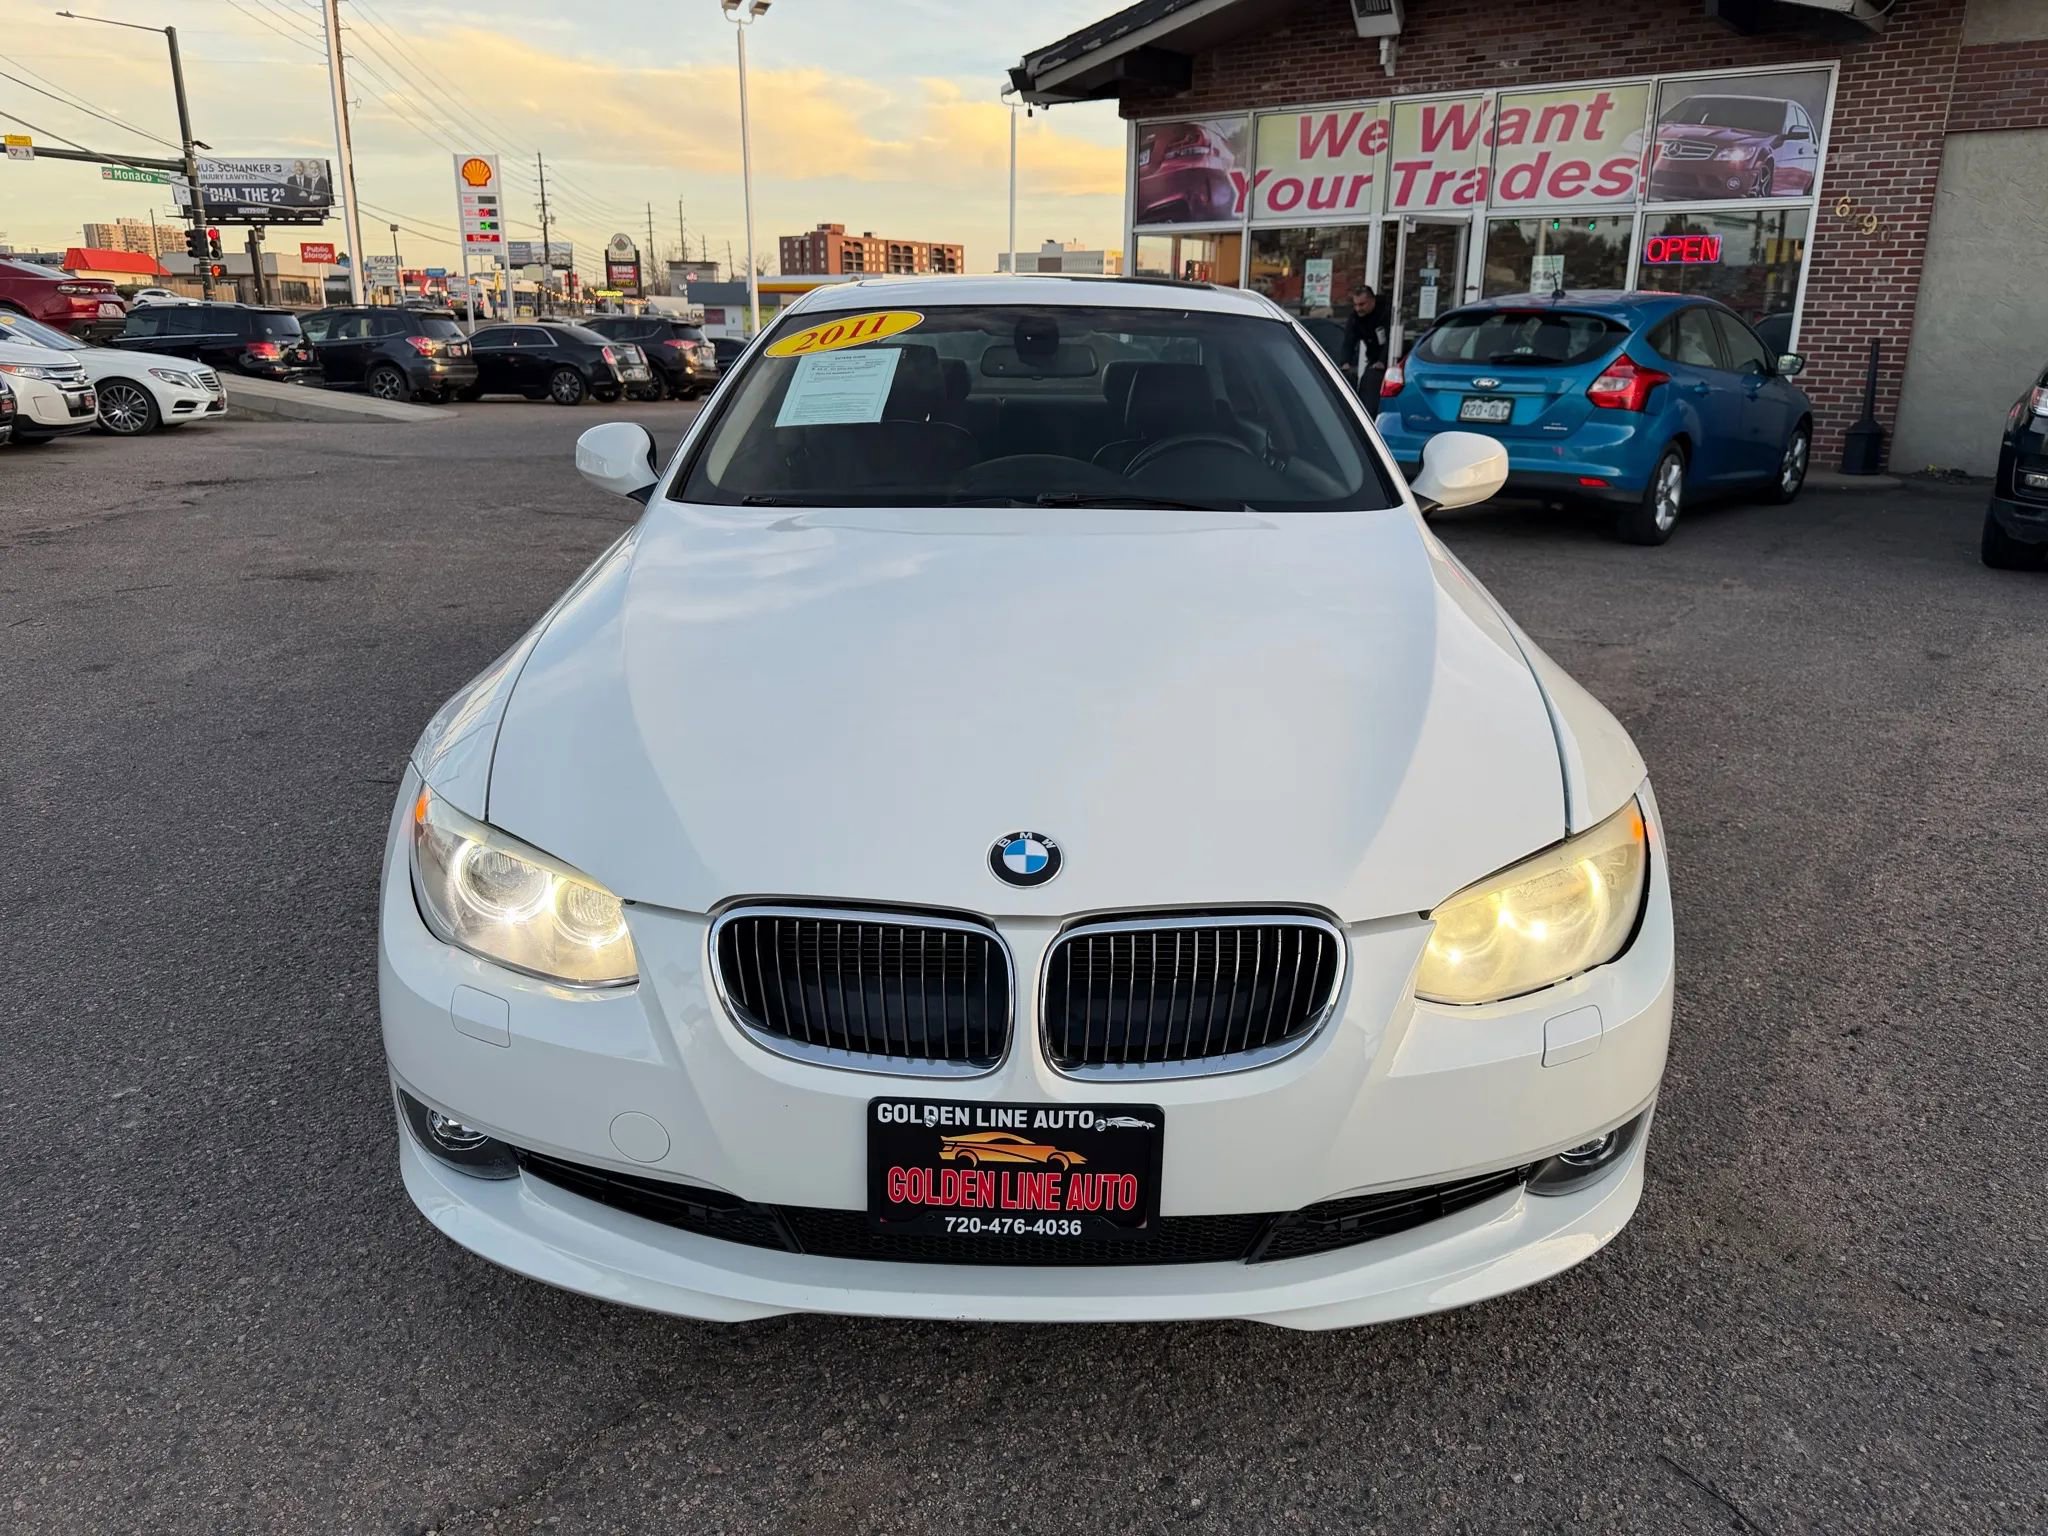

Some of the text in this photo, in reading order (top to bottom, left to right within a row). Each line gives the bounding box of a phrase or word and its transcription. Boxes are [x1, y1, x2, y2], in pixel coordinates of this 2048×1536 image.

[1300, 91, 1613, 159] We Want
[114, 169, 153, 182] Monaco
[217, 163, 272, 174] SCHANKER
[1230, 142, 1663, 213] Your Trades!
[210, 187, 240, 202] DIAL
[242, 187, 268, 202] THE
[303, 251, 333, 261] Storage
[306, 245, 329, 254] Public
[1647, 235, 1719, 263] OPEN
[374, 256, 395, 264] 6625
[790, 315, 889, 353] 2011
[997, 832, 1057, 849] BMW
[877, 1103, 1094, 1130] GOLDEN LINE AUTO
[887, 1166, 1138, 1211] GOLDEN LINE AUTO
[944, 1216, 1083, 1236] 720-476-4036
